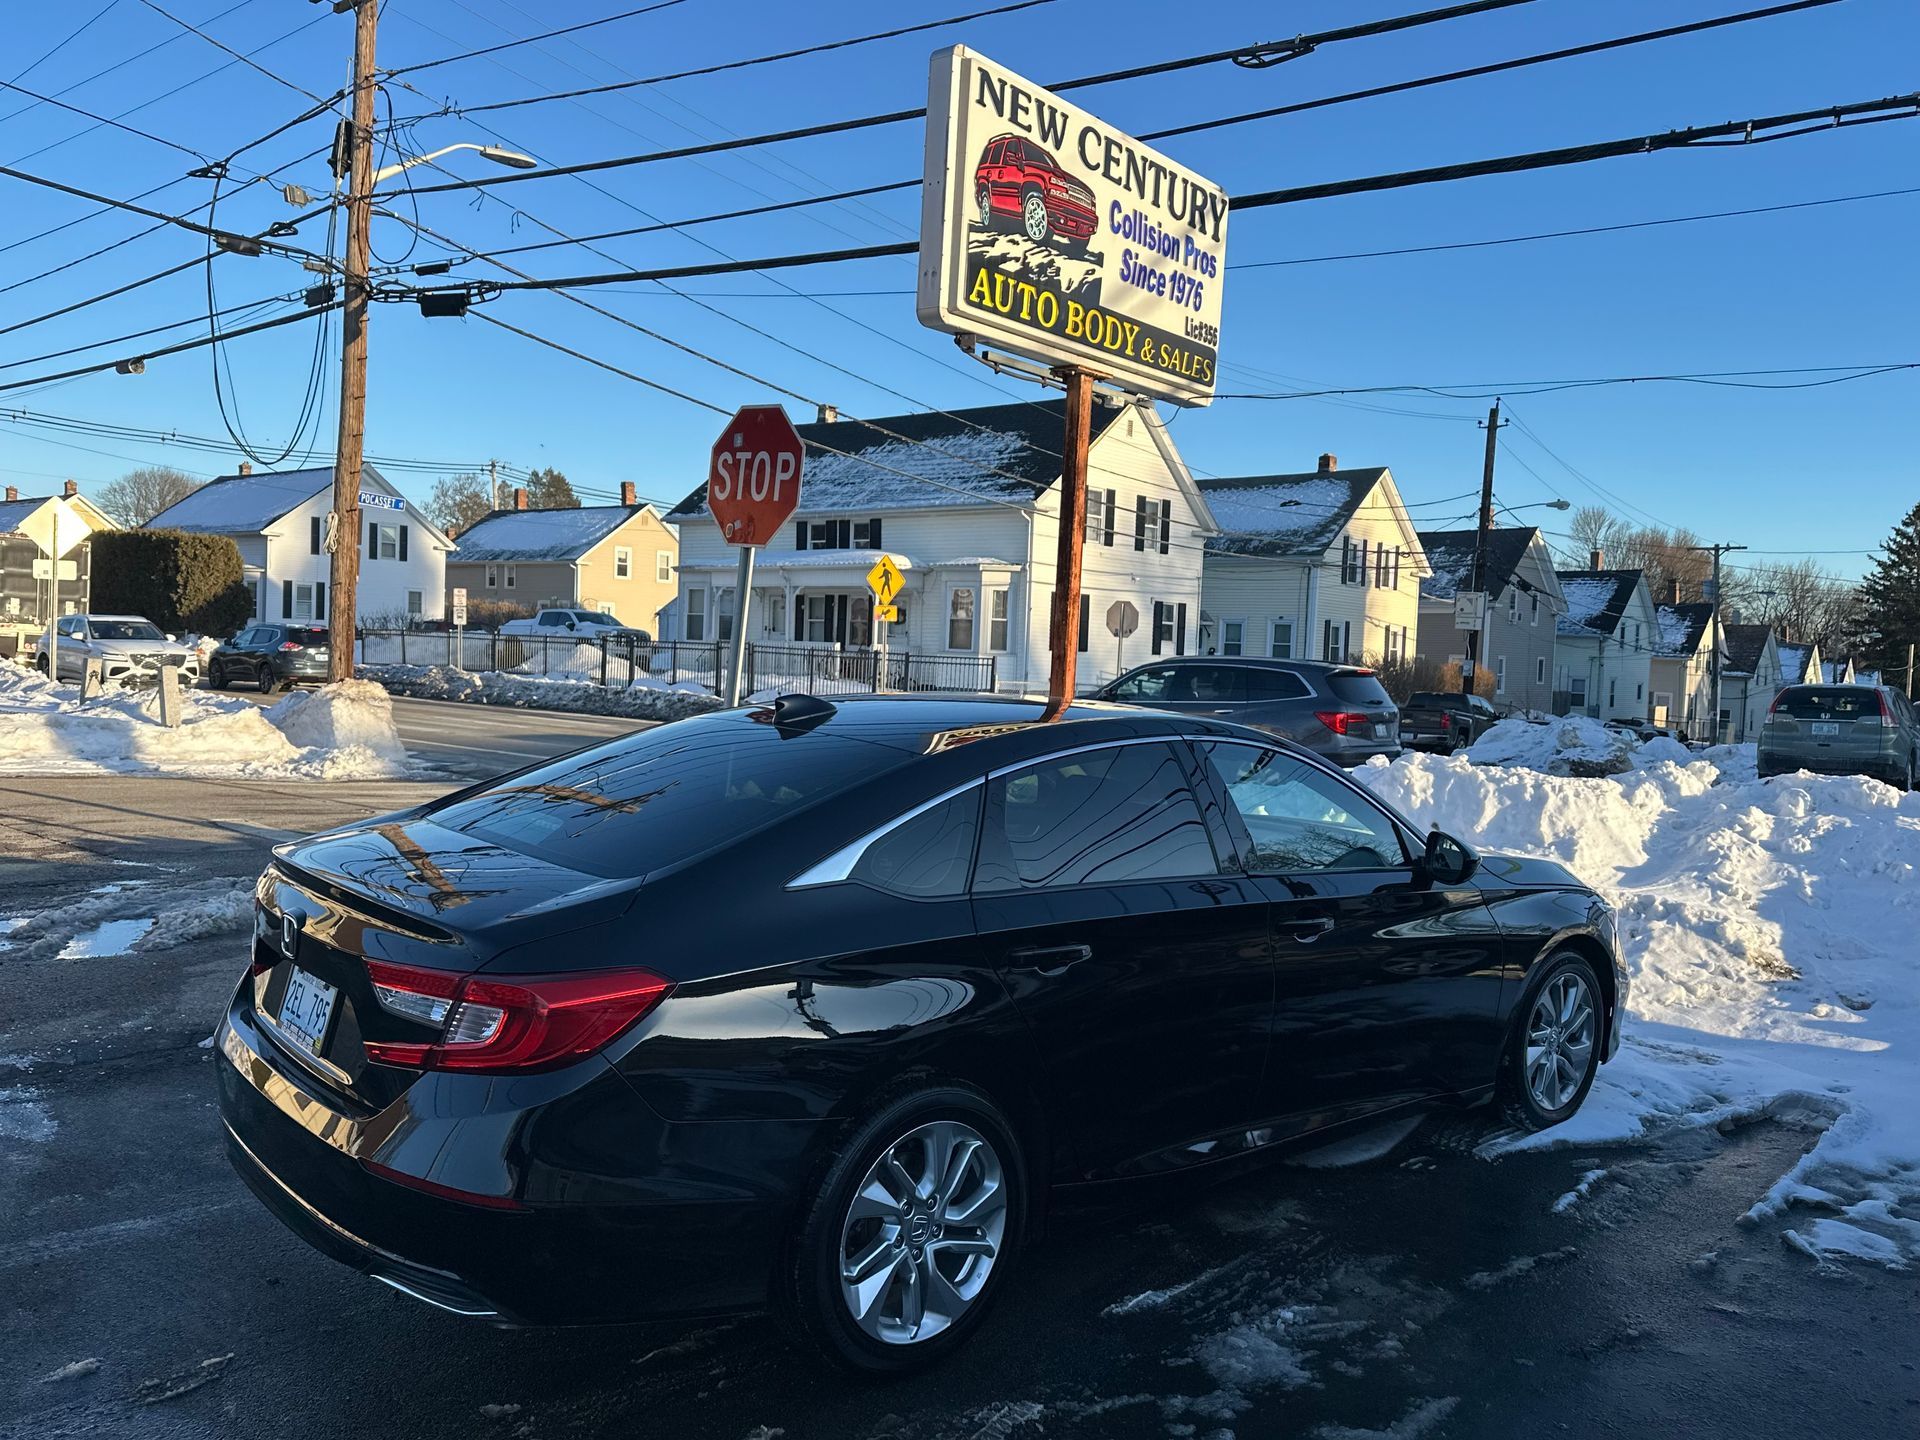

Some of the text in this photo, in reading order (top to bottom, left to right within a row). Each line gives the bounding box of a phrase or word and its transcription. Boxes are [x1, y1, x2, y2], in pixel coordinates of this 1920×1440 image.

[975, 66, 1229, 243] NEW CENTURY
[1109, 199, 1217, 279] Collision Pros
[1120, 248, 1205, 312] Since 1976
[970, 267, 1213, 383] AUTO BODY & SALES
[361, 493, 396, 508] POCASSET
[714, 450, 796, 502] STOP
[285, 979, 306, 1020] 2EL
[307, 993, 331, 1035] 795
